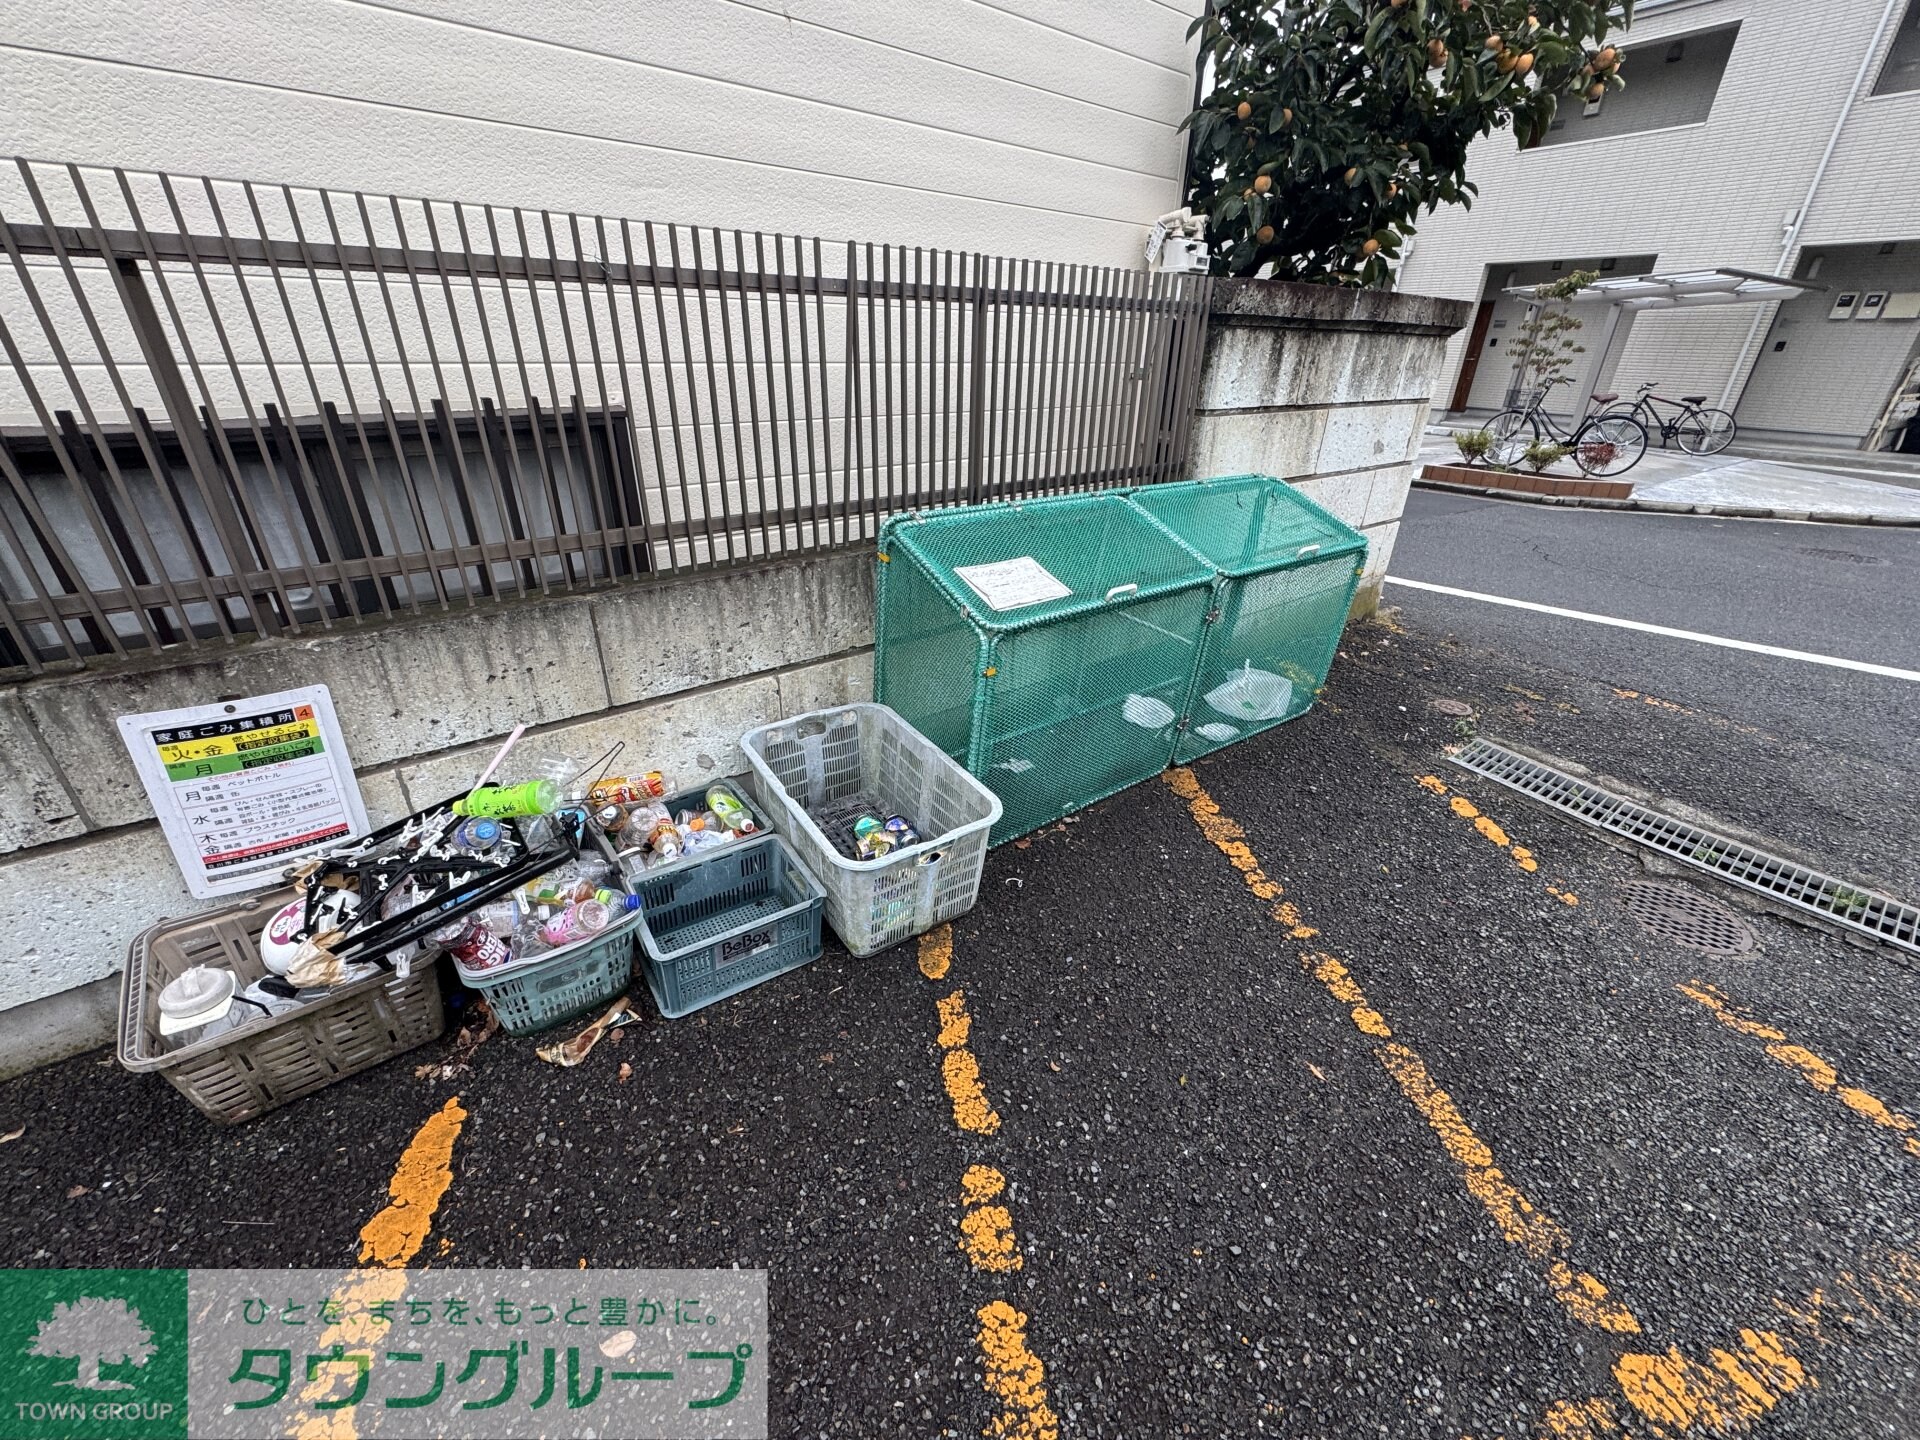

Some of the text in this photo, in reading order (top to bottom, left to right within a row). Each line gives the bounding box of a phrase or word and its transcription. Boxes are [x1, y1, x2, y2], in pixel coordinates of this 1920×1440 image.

[156, 708, 310, 743] 家庭ごみ集積所 4
[232, 723, 311, 741] 燃やせるごみ
[237, 741, 316, 760] 燃やせないごみ
[193, 763, 213, 776] 月
[228, 772, 281, 786] ペットボトル
[184, 790, 202, 801] 月
[192, 814, 210, 825] 水
[200, 833, 217, 844] 木
[244, 818, 296, 832] プラスチック
[204, 844, 221, 855] 金
[722, 930, 770, 956] BeBox
